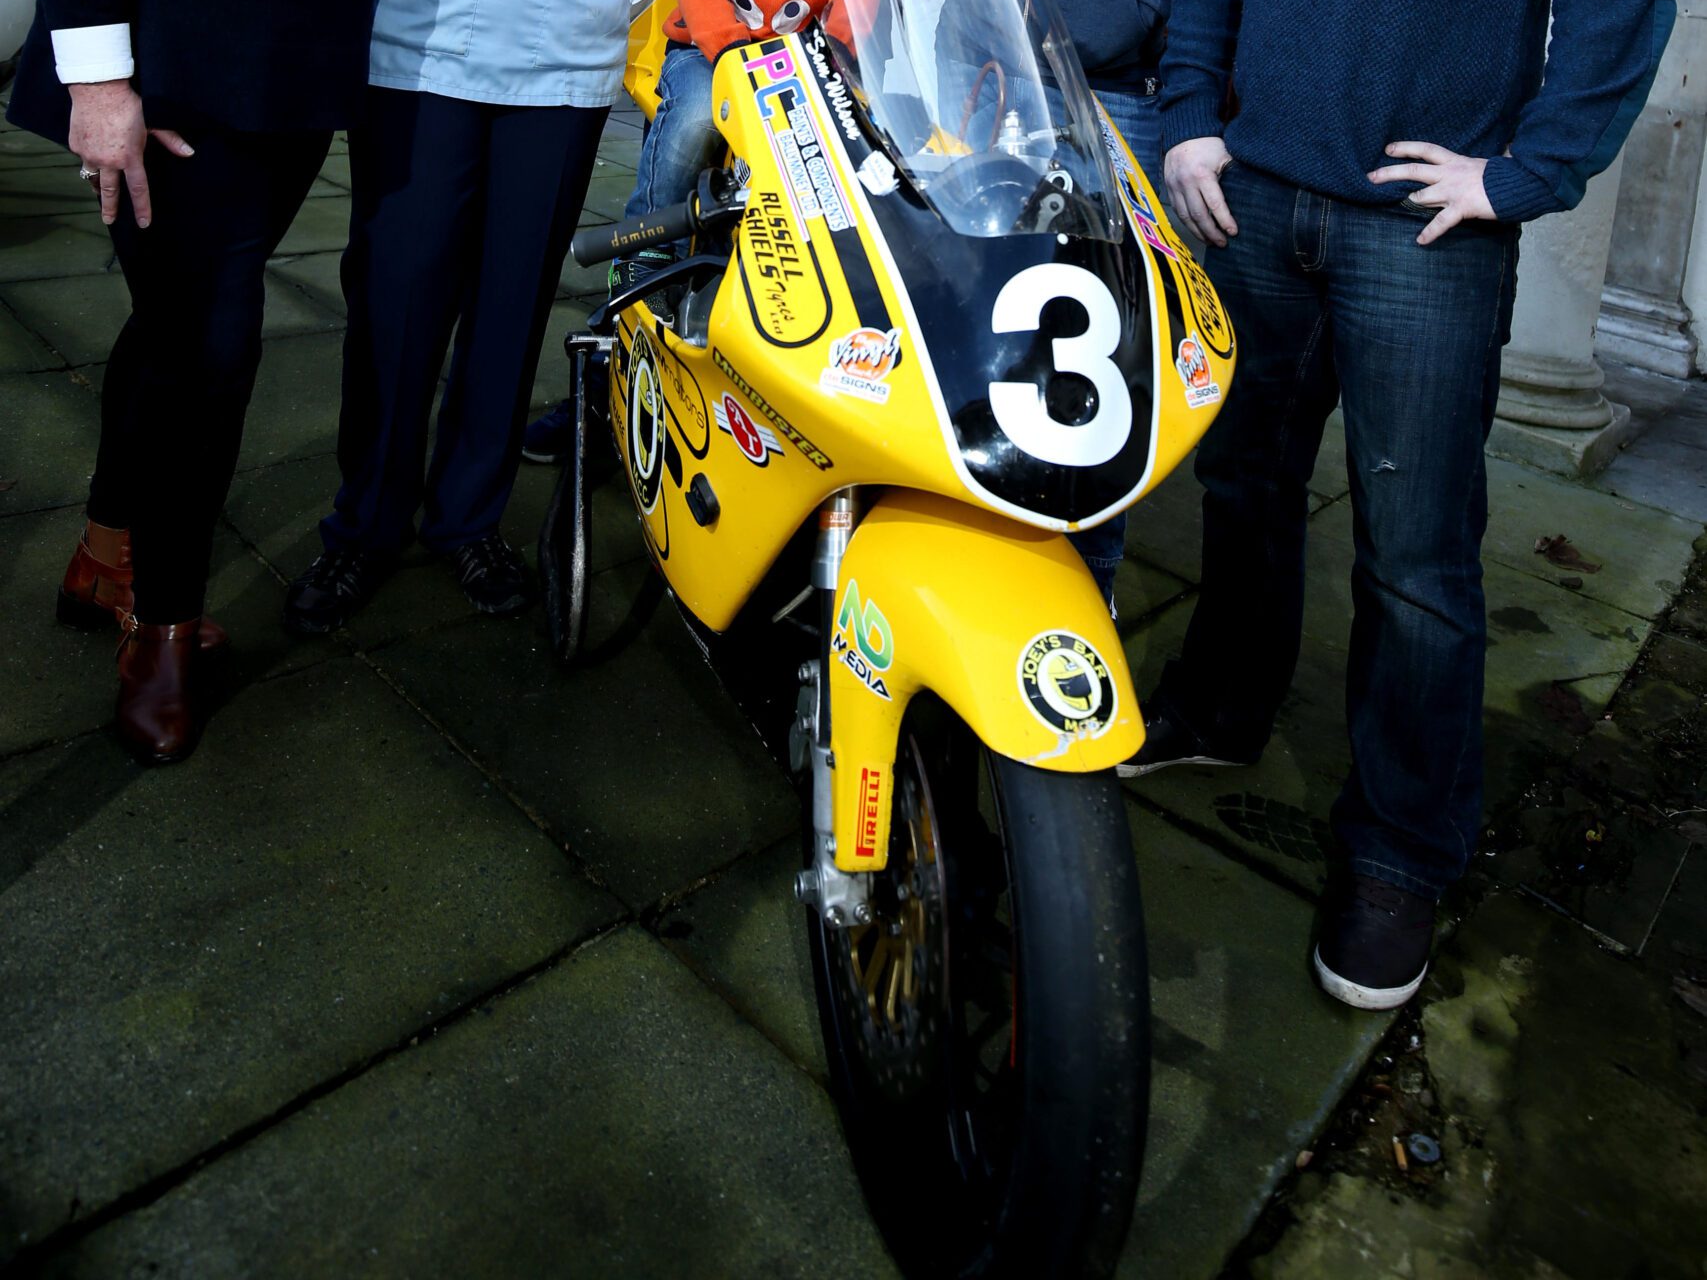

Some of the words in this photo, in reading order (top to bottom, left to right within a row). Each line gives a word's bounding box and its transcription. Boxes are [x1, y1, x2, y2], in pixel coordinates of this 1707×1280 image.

[744, 47, 807, 119] PC
[824, 71, 861, 141] Wilson
[791, 108, 814, 145] PAINTS
[808, 159, 848, 231] COMPONENTS
[611, 222, 665, 248] domino
[744, 207, 781, 280] SHIELS
[759, 191, 803, 281] RUSSELL
[988, 262, 1133, 468] 3
[832, 632, 891, 700] MEDIA
[1023, 634, 1062, 685] JOEY'S
[1072, 639, 1107, 680] BAR
[855, 767, 881, 858] PIRELLI
